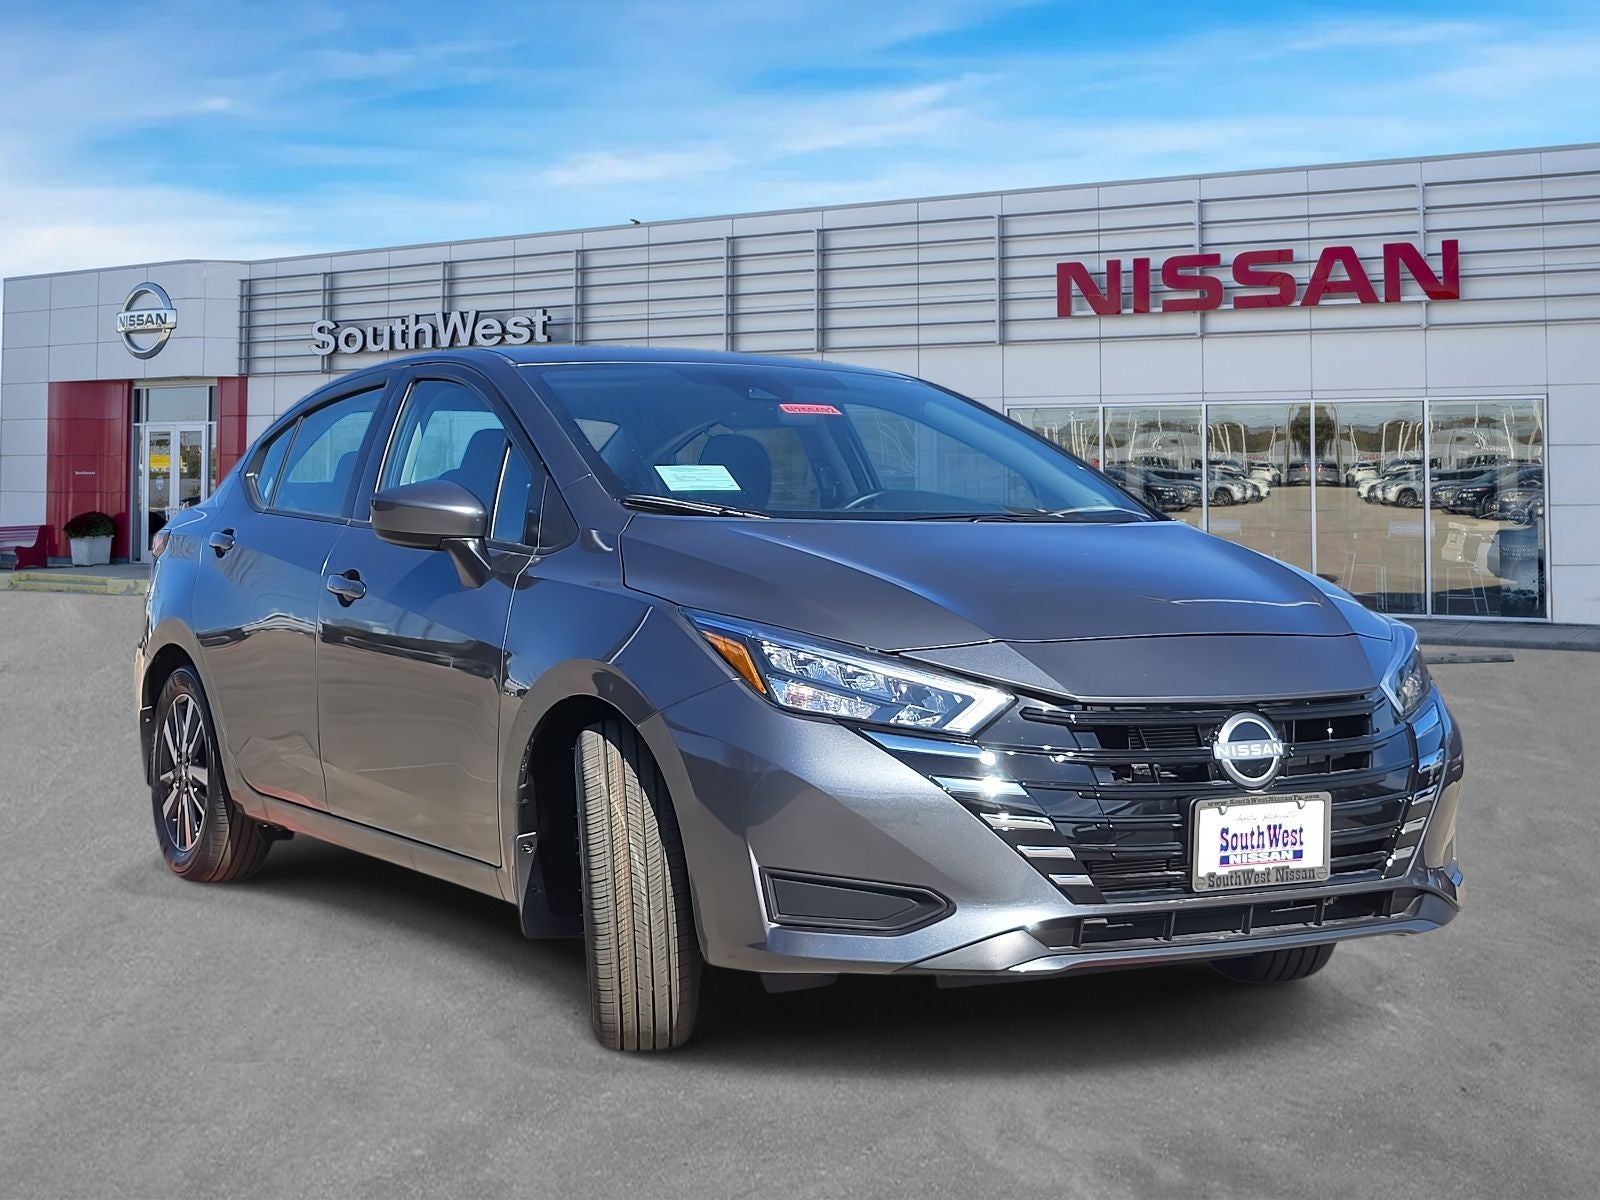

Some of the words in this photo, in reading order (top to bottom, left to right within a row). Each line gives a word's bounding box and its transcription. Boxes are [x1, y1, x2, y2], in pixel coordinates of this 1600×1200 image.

[1056, 239, 1461, 317] NISSAN
[119, 312, 167, 328] NISSAN
[310, 308, 551, 355] SouthWest
[1215, 742, 1283, 758] NISSAN
[1220, 824, 1304, 852] SouthWest
[1229, 850, 1293, 865] NISSAN
[1207, 868, 1271, 888] SouthWest
[1275, 867, 1315, 882] Nissan
